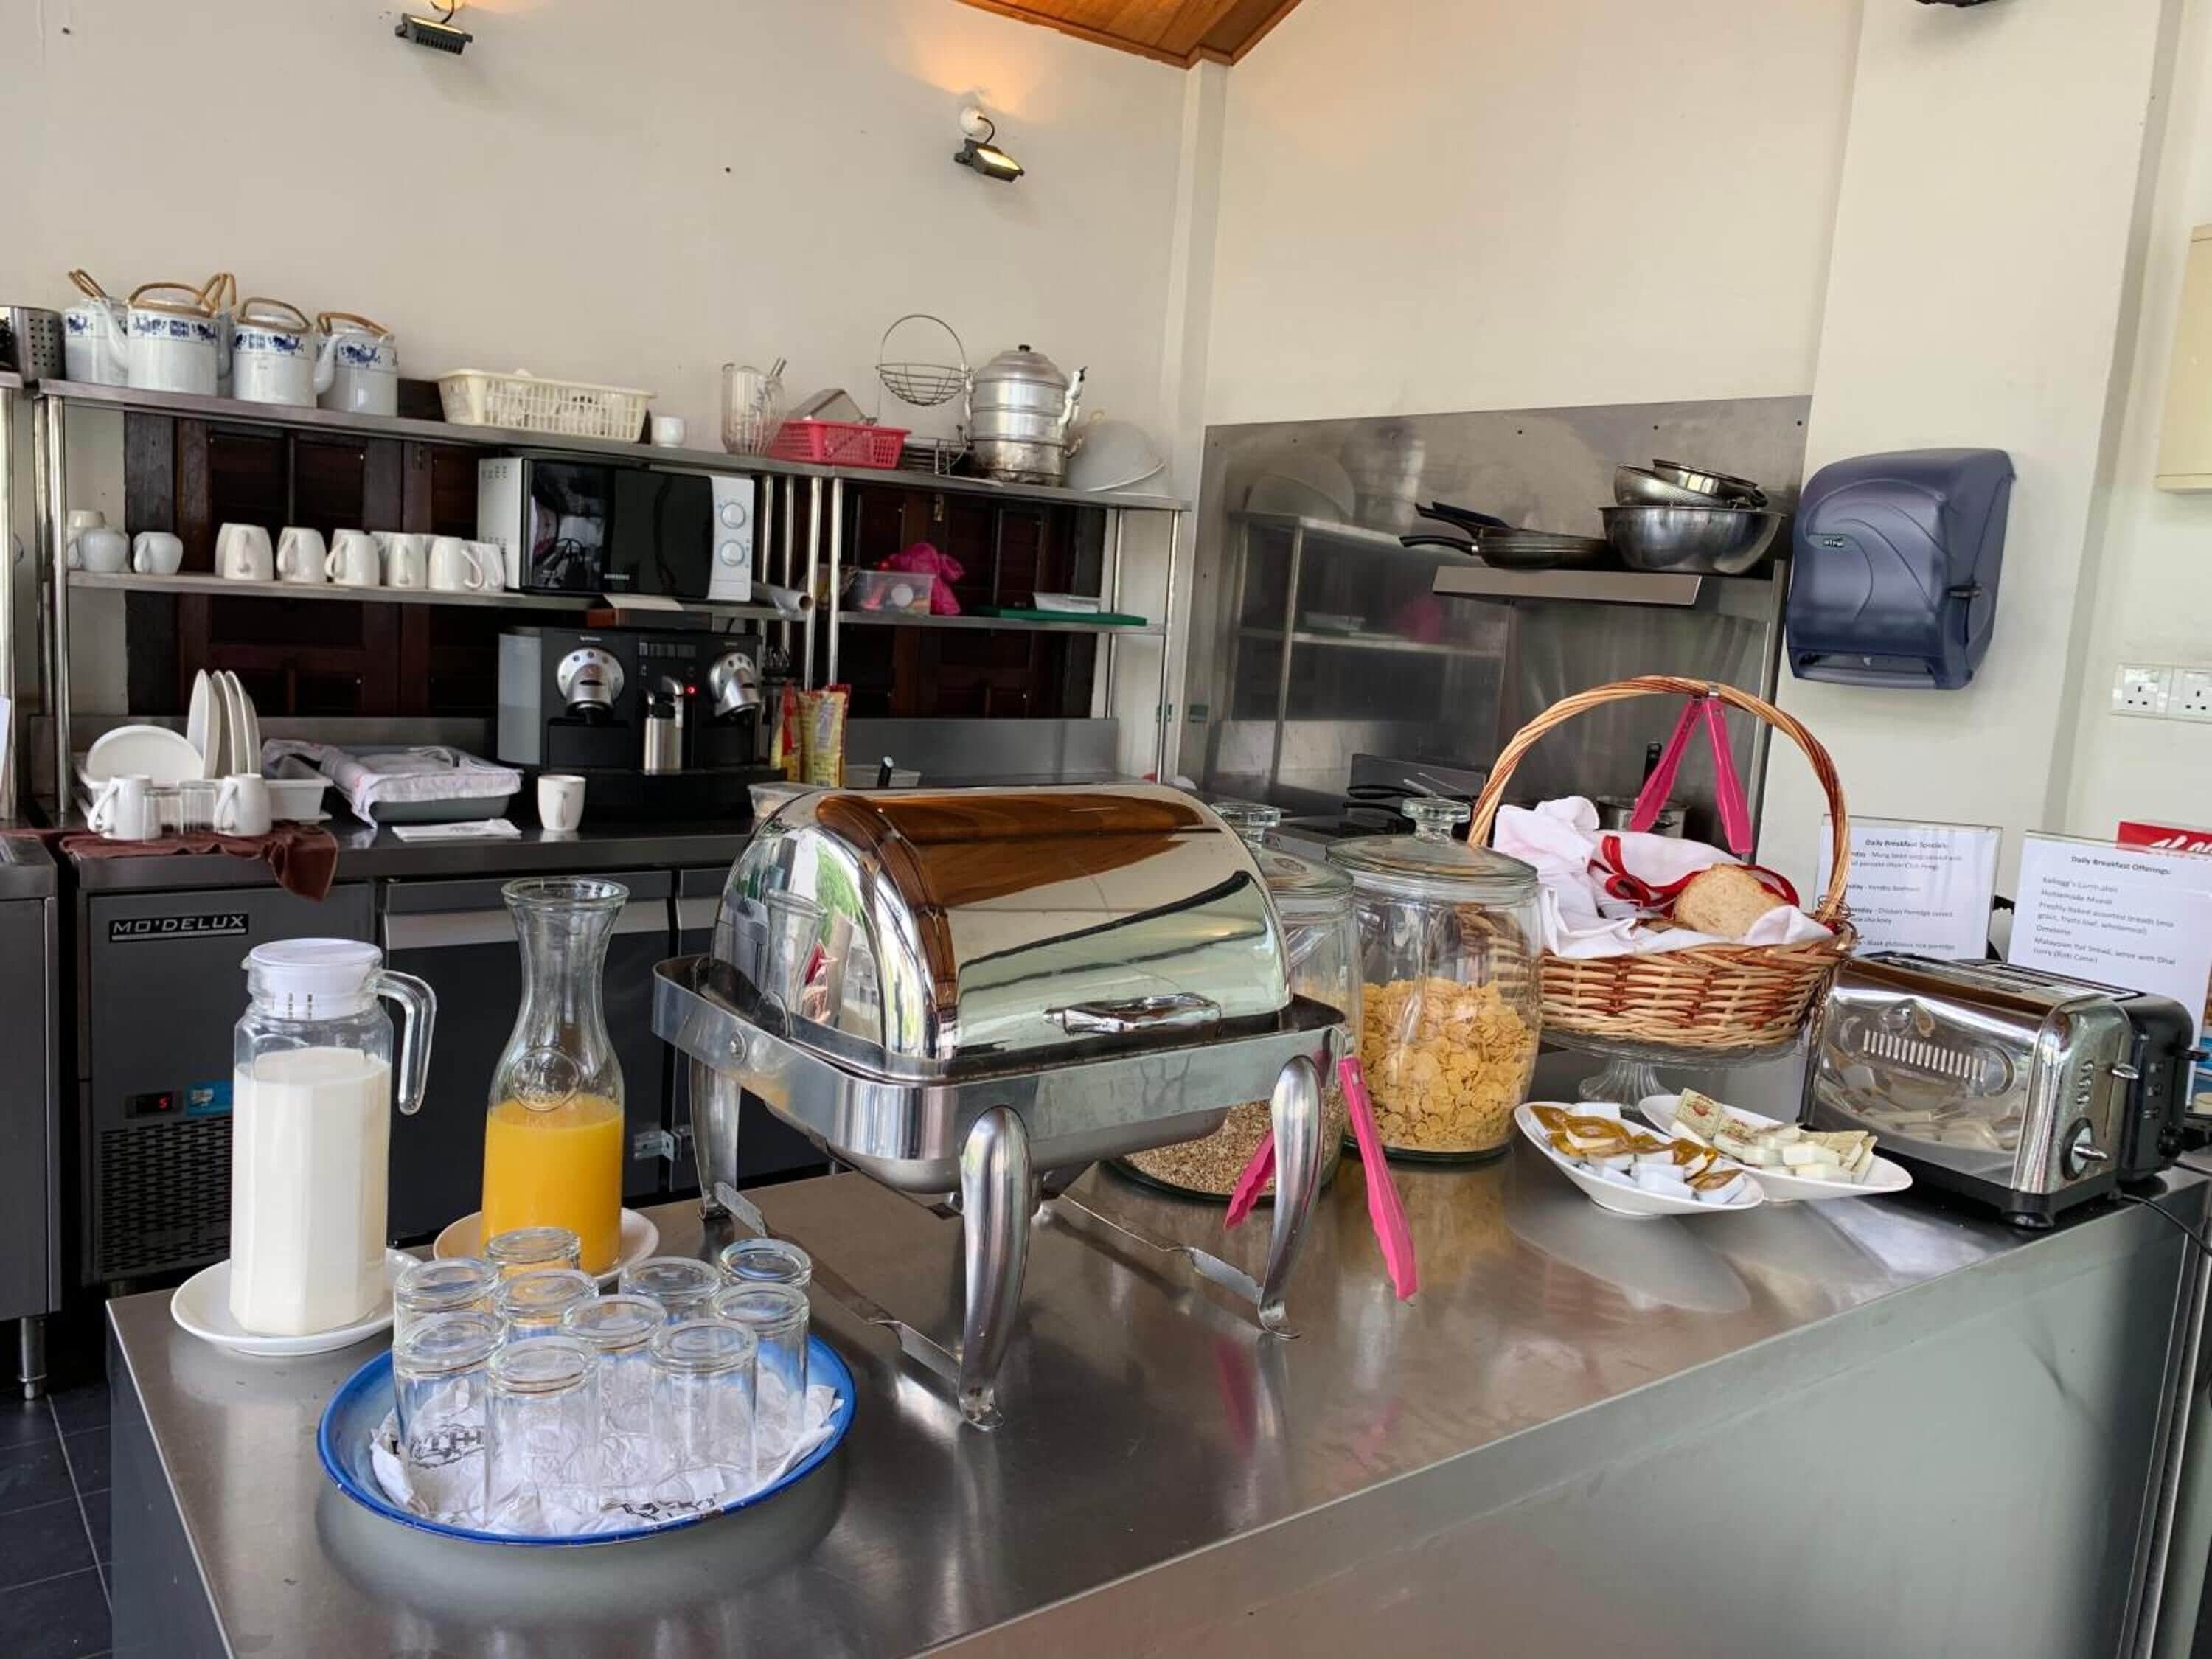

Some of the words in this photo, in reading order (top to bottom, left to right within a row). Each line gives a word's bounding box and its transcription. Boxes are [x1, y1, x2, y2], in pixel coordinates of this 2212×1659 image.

[1865, 838, 1882, 846] Daily
[1885, 839, 1917, 847] Breakfast
[2071, 855, 2090, 866] Daily
[2093, 858, 2131, 870] Breakfast
[2042, 876, 2076, 888] Kellogg's
[2041, 889, 2084, 902] Homemade
[2039, 902, 2066, 913] Freshly
[2067, 905, 2091, 915] baked
[2092, 911, 2126, 921] assorted
[113, 915, 243, 933] MO'DELUX
[2036, 924, 2072, 935] Omelette
[2138, 953, 2154, 963] with
[2156, 956, 2177, 965] Dhal
